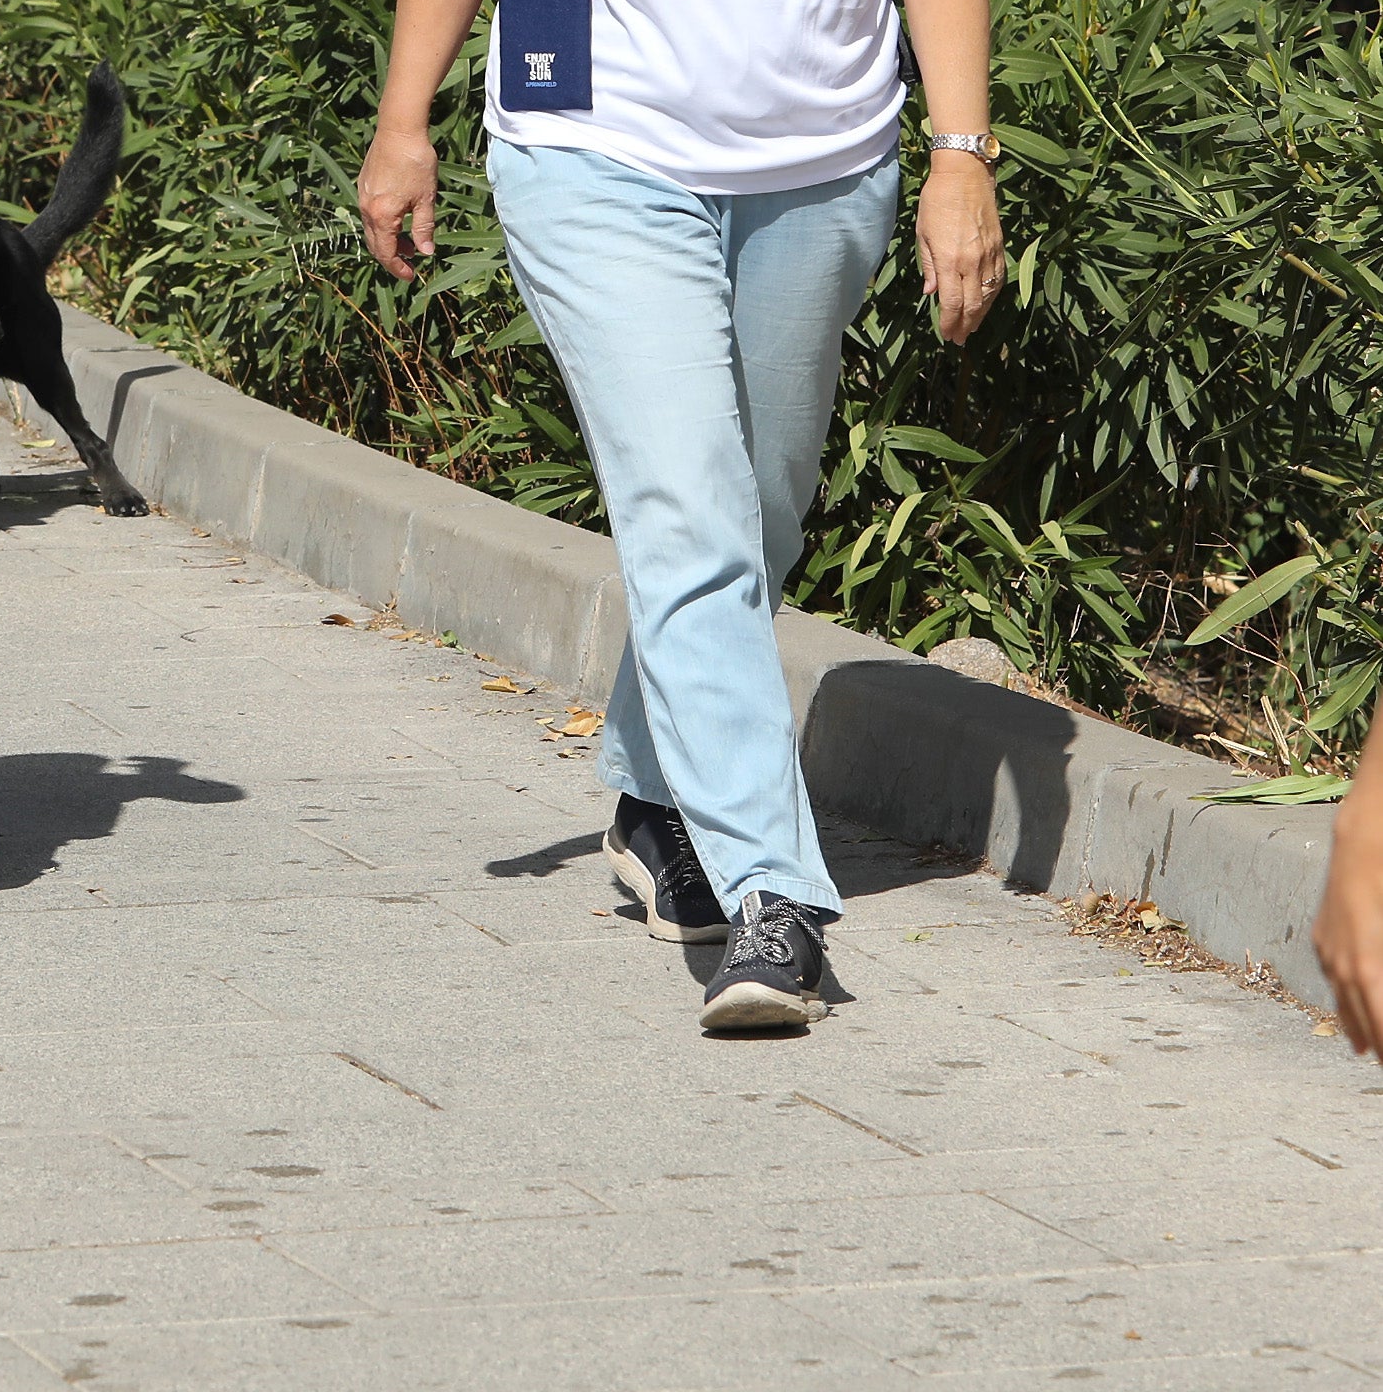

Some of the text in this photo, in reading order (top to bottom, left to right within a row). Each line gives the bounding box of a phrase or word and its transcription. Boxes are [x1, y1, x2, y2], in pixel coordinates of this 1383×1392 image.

[525, 53, 555, 63] ENJOY
[530, 62, 551, 71] THE
[530, 70, 552, 81] SUN
